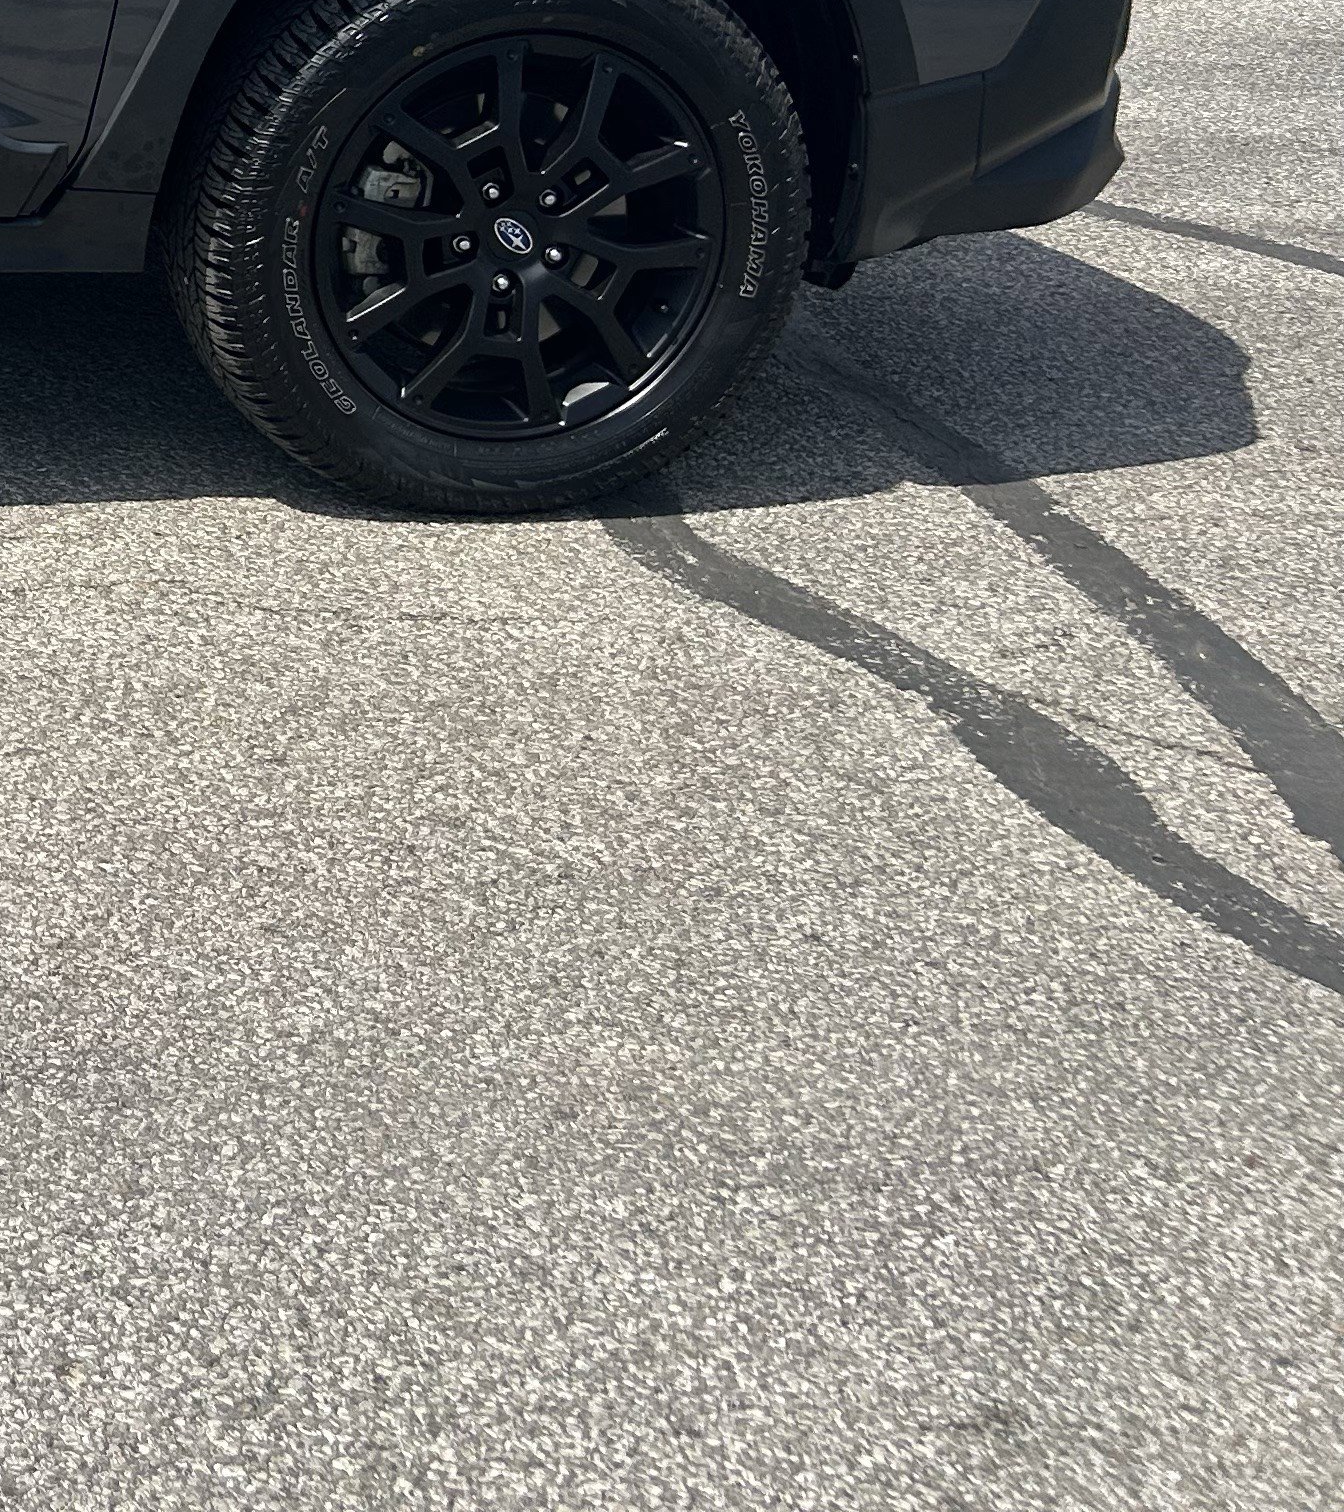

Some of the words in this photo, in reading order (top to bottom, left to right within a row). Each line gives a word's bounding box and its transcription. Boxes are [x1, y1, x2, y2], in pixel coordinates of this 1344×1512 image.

[297, 126, 330, 193] A/T
[728, 110, 770, 299] YOKOHAMA
[282, 217, 357, 415] GEOLANDAR
